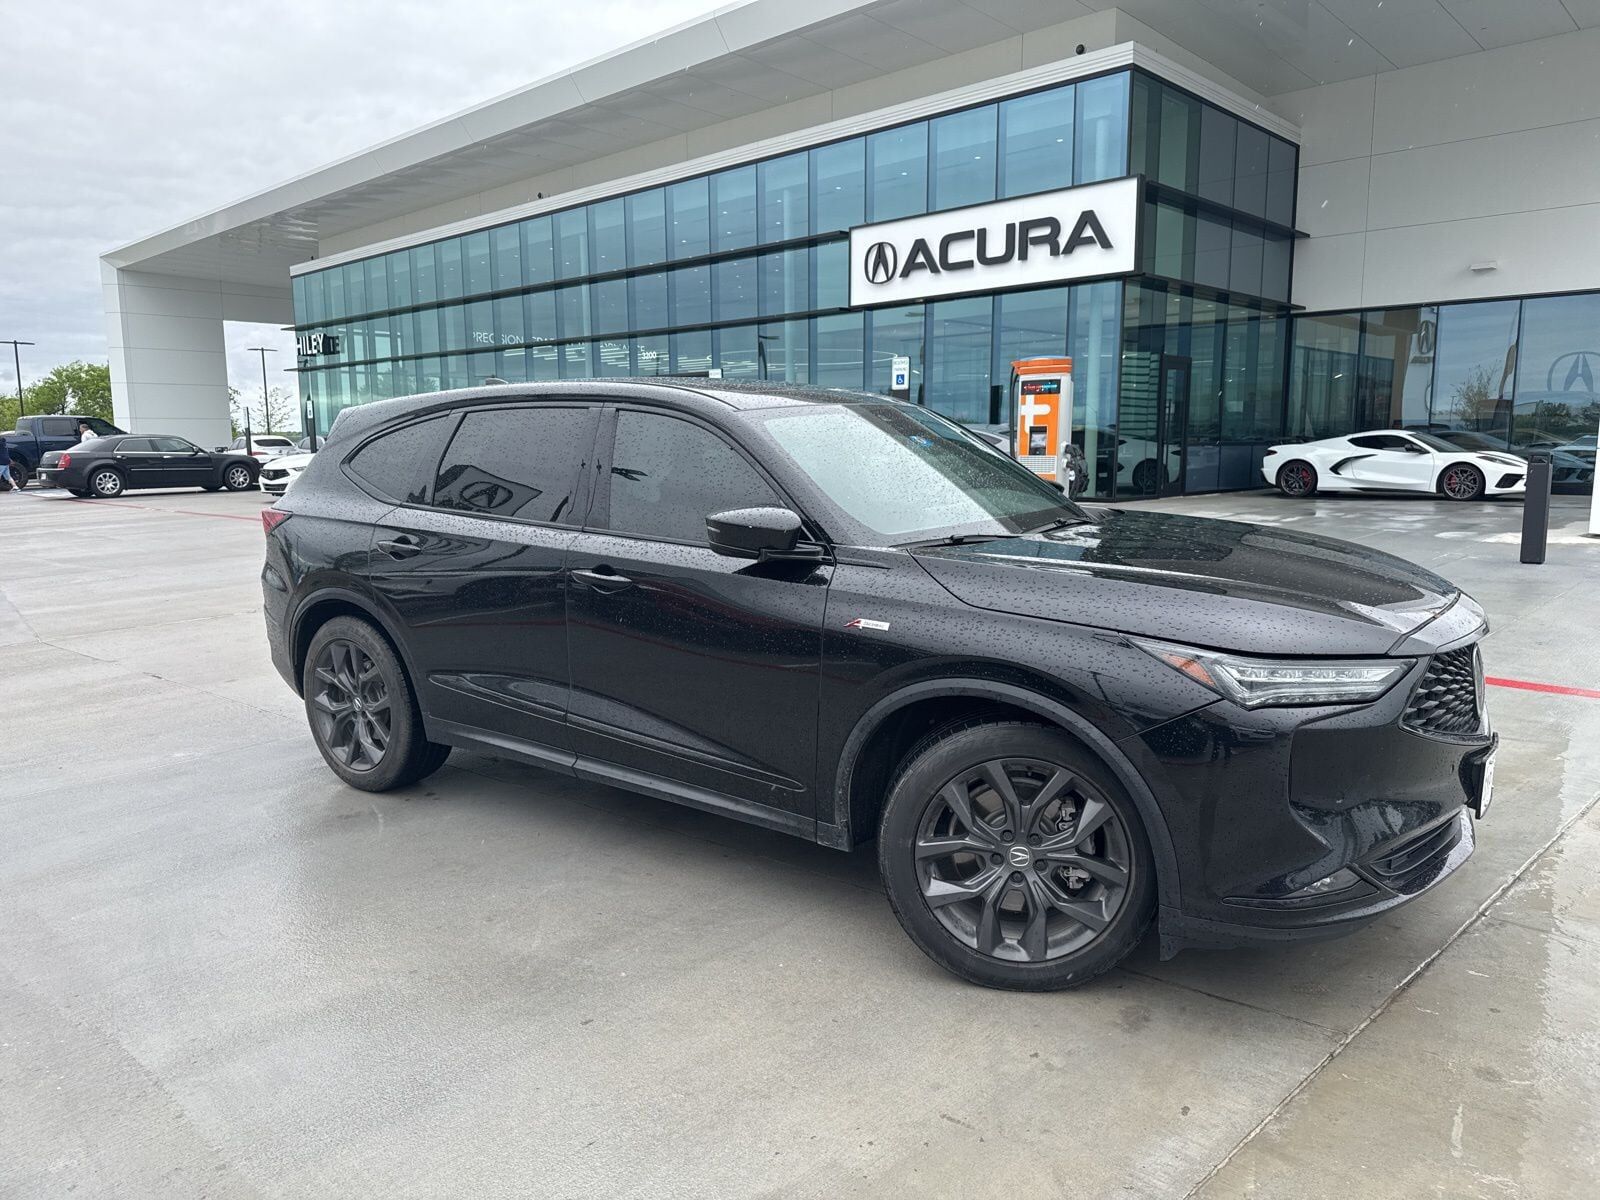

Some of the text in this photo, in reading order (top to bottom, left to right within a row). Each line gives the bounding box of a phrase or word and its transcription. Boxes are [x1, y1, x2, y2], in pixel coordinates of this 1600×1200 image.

[899, 209, 1114, 278] ACURA
[296, 332, 324, 356] HILEY
[472, 331, 525, 345] RECSION
